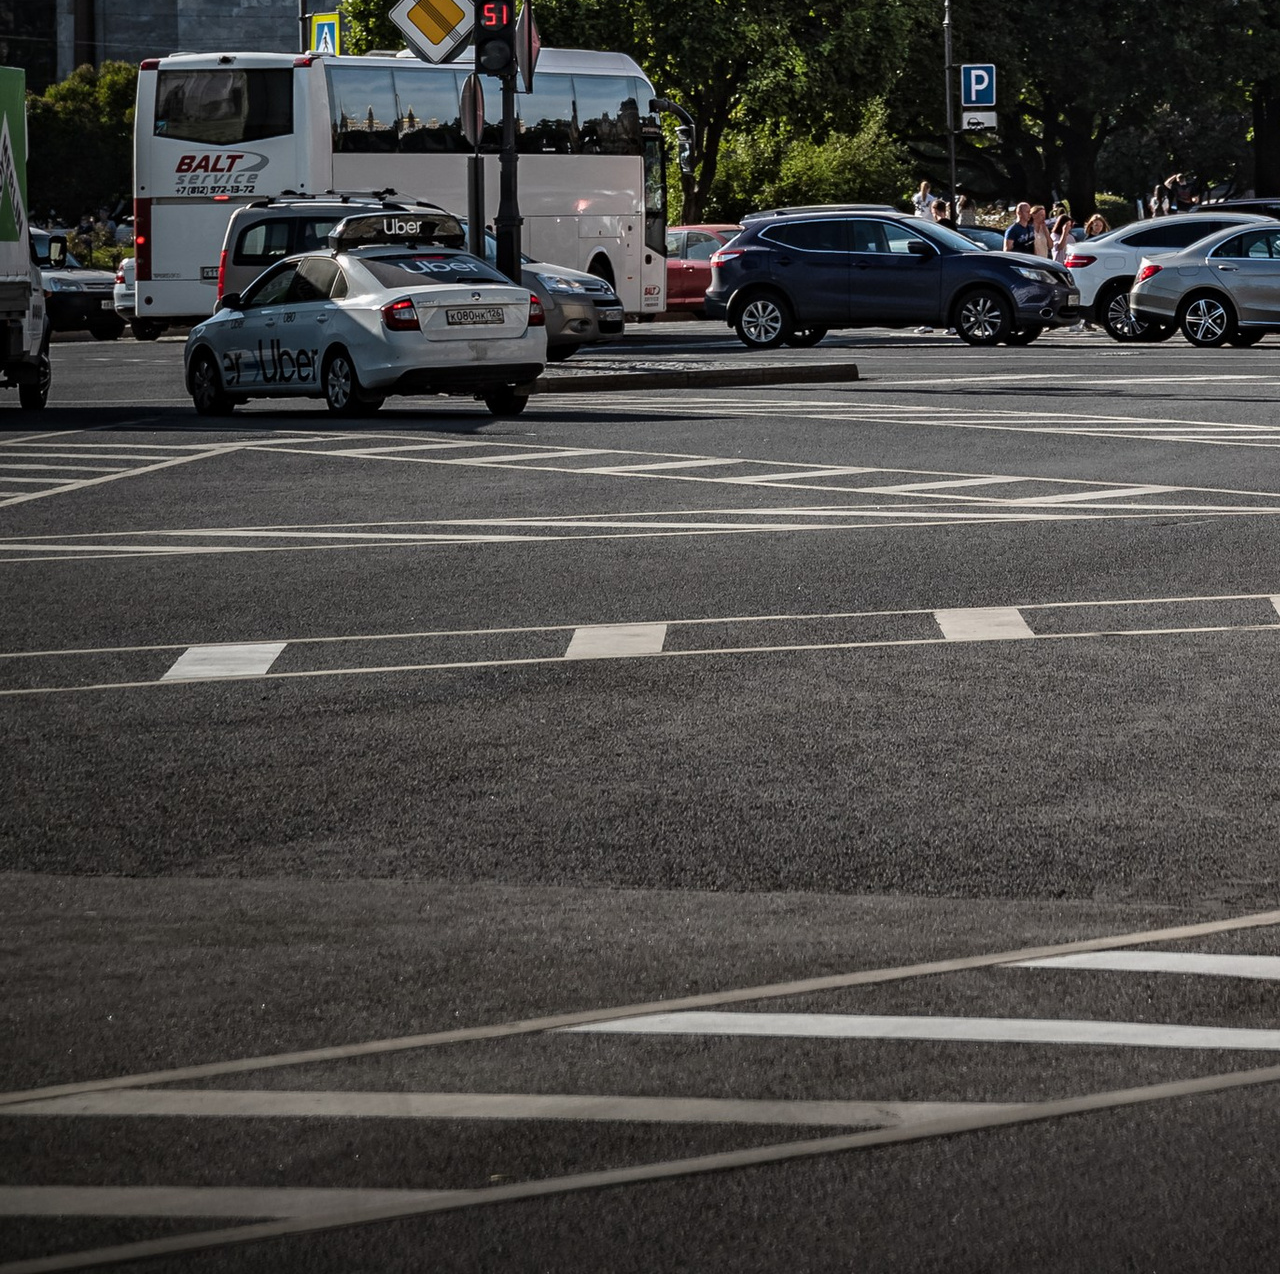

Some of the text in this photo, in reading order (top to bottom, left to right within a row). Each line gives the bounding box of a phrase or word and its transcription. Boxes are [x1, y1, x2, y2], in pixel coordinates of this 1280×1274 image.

[483, 4, 507, 26] 51
[971, 70, 989, 101] P
[175, 154, 244, 173] BALT
[175, 173, 259, 185] service
[176, 185, 255, 195] +7 (812) 972-13-72
[383, 219, 422, 235] Uber
[398, 260, 479, 274] Uber
[487, 308, 501, 317] 126
[258, 339, 318, 383] Uber
